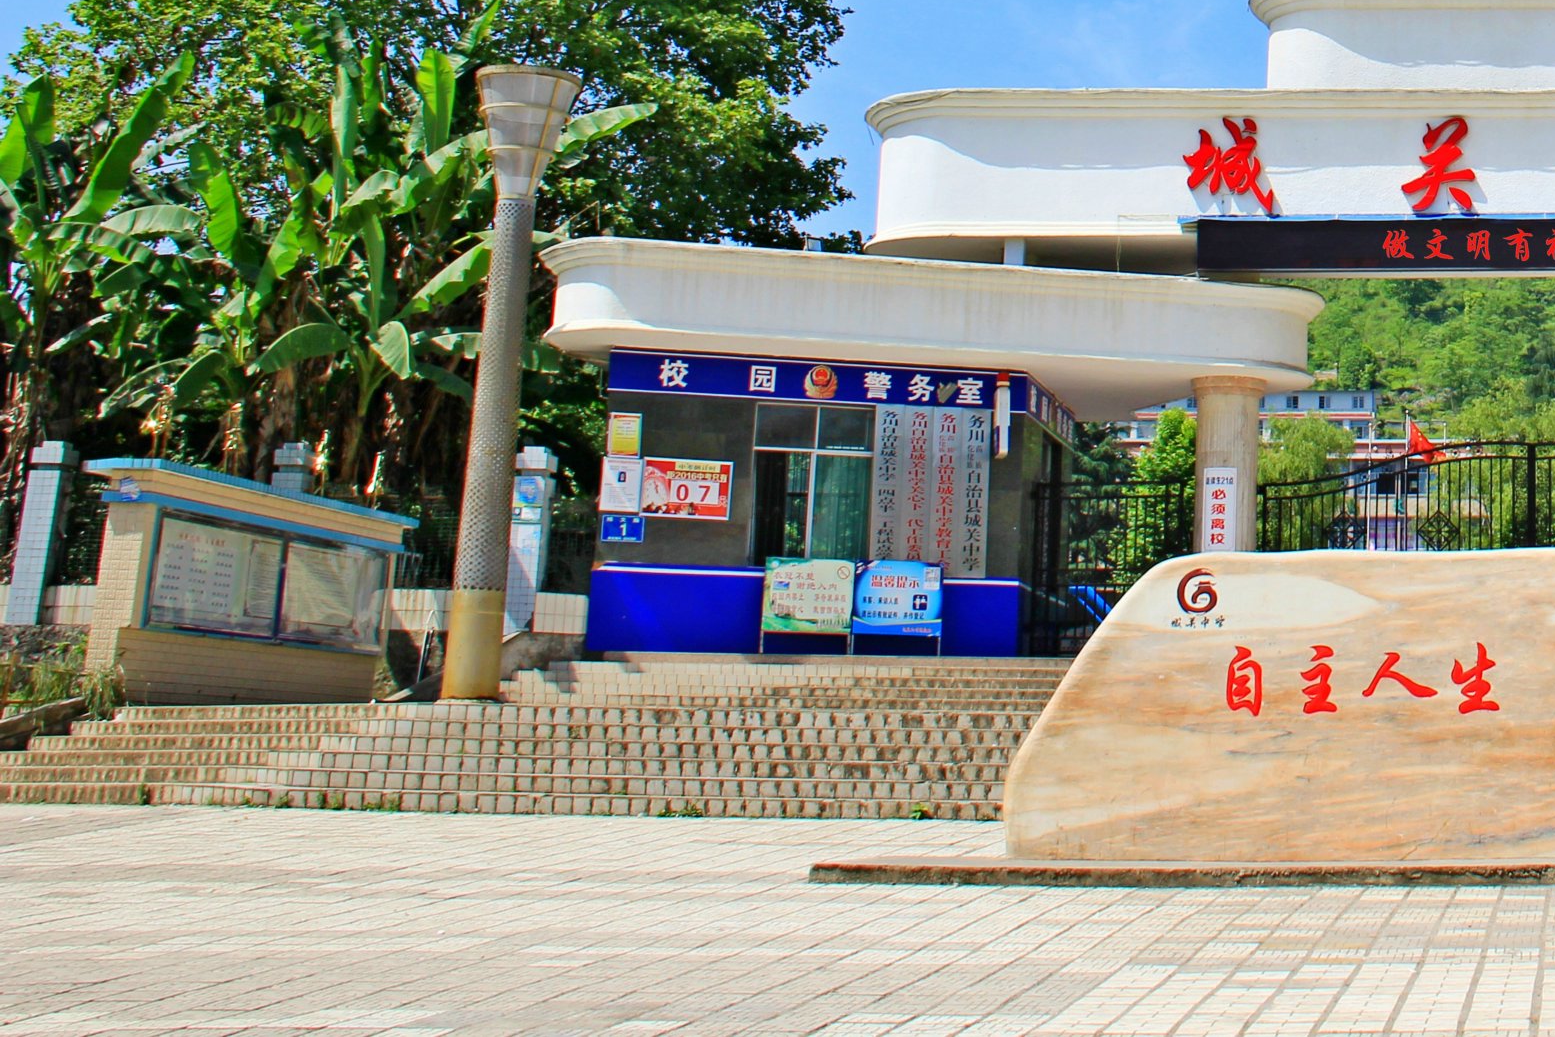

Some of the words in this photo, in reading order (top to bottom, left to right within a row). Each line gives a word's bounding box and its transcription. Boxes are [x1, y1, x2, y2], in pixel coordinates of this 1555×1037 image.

[659, 359, 983, 404] 校园警务室
[619, 523, 628, 536] 1
[1210, 488, 1226, 545] 必须离校
[871, 574, 919, 589] 温馨提示
[1225, 642, 1501, 717] 自主人生
